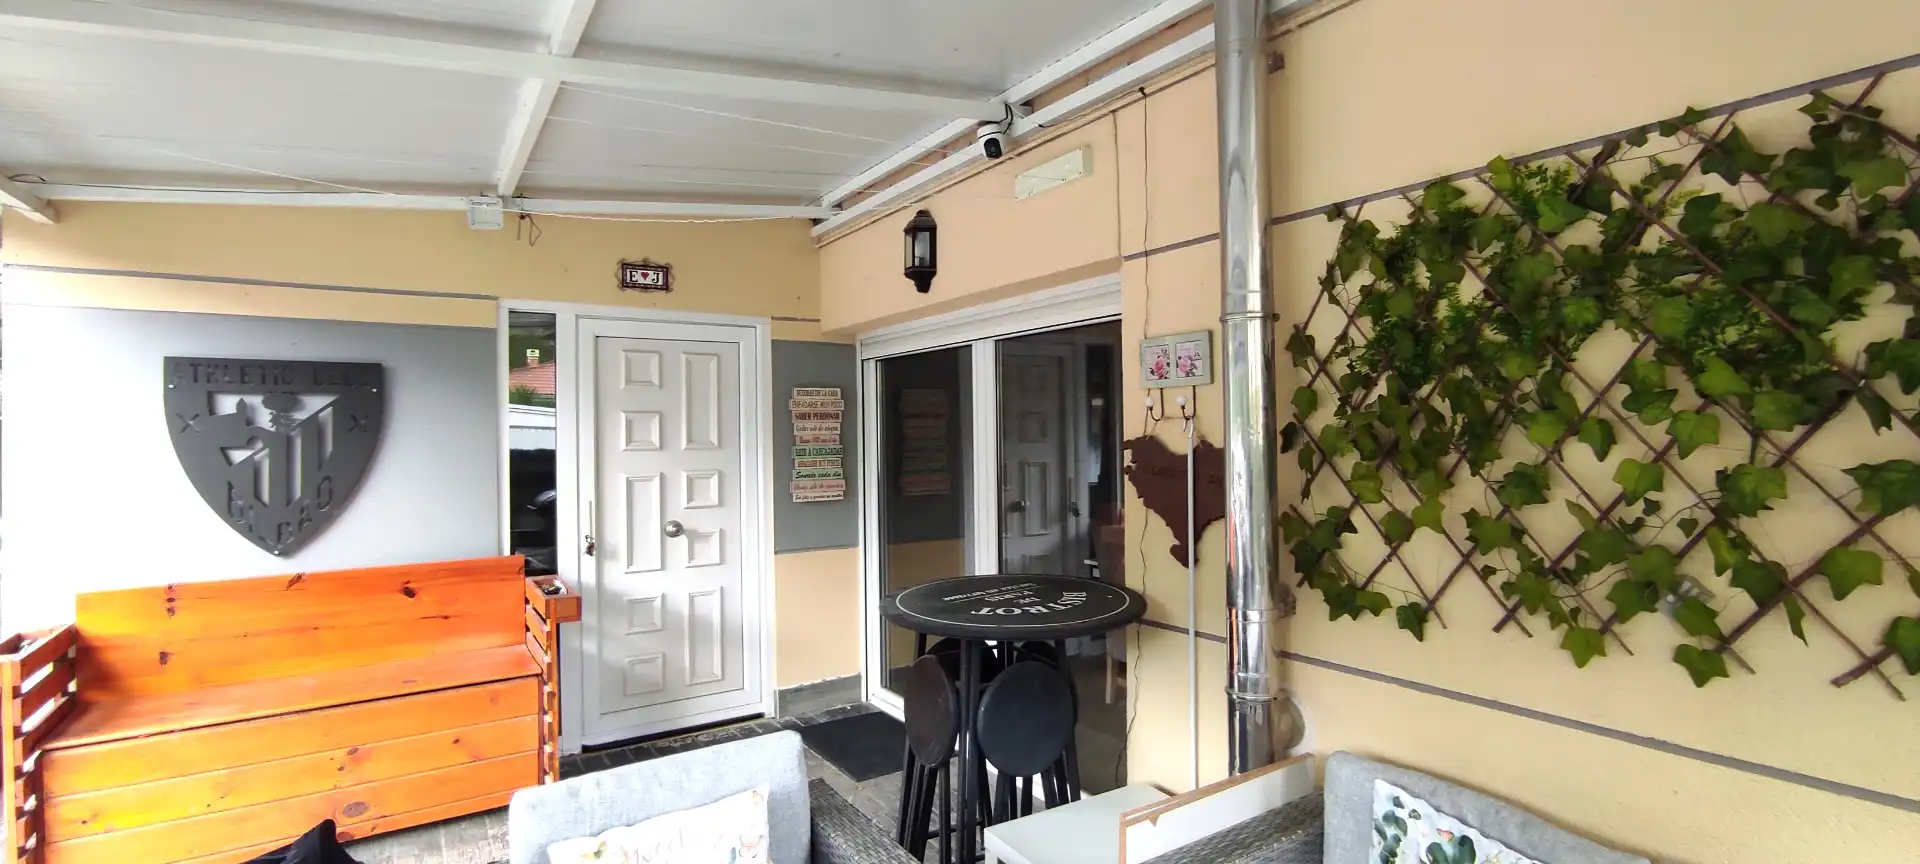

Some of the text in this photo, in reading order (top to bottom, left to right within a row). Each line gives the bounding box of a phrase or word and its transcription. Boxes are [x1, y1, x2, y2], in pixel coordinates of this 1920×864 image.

[629, 270, 660, 283] E J
[792, 400, 819, 409] ENFADARSE
[795, 412, 840, 421] SABER PERDONAR
[970, 591, 1087, 616] BISTROT
